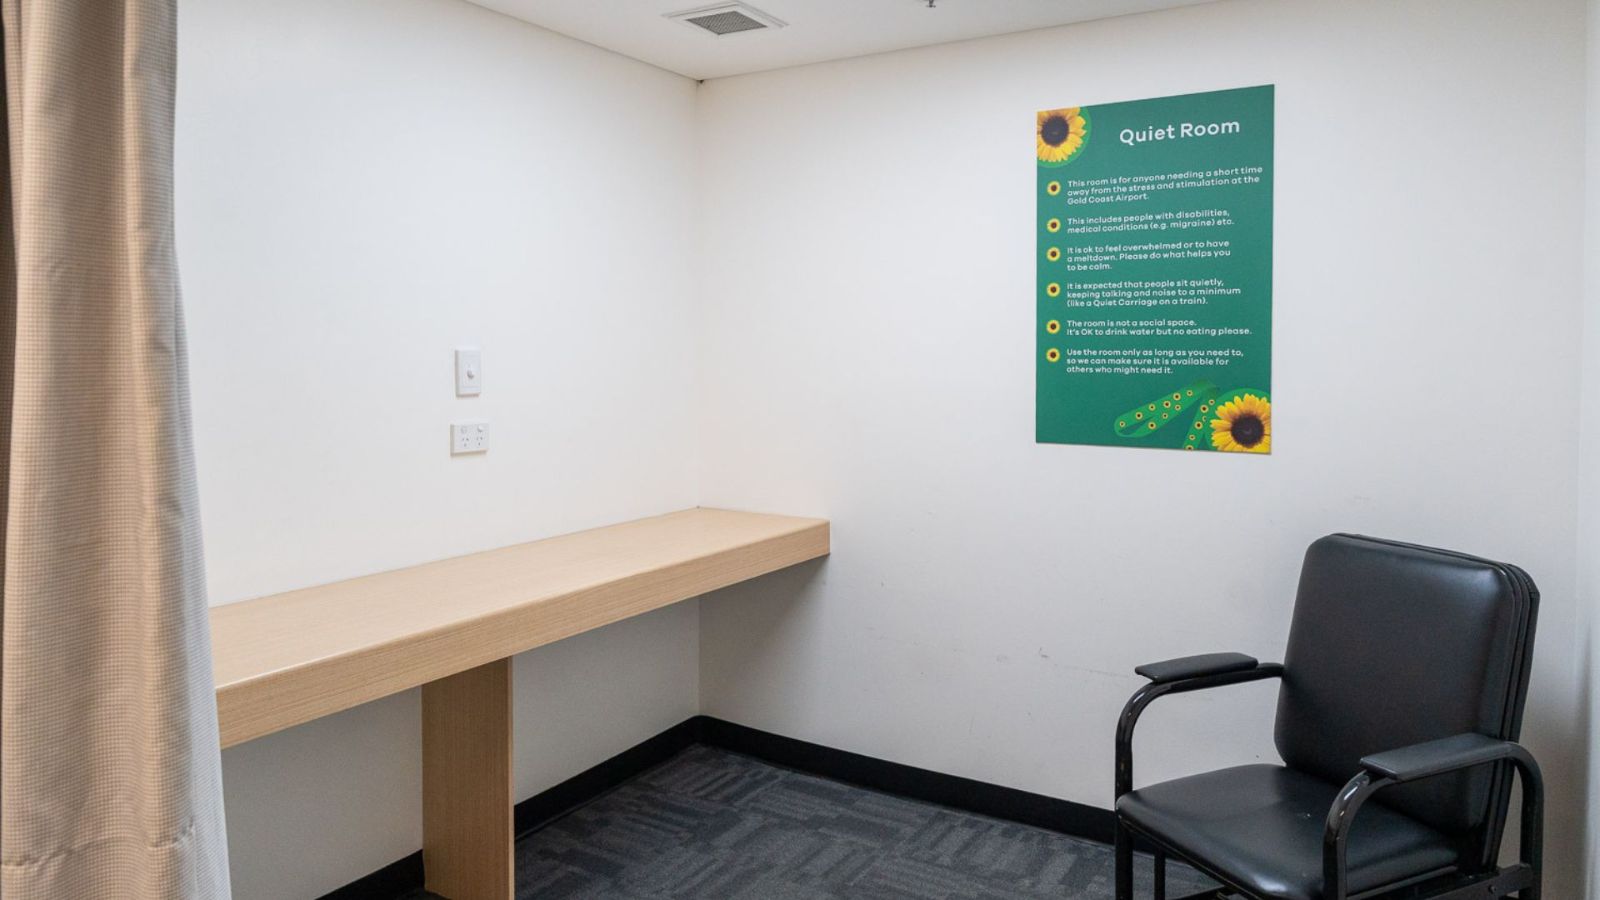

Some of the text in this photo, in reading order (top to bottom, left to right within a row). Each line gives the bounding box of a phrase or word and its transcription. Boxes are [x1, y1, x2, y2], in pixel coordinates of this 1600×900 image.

[1119, 121, 1240, 145] Quiet Room
[1119, 176, 1131, 184] for
[1133, 175, 1165, 184] anyone
[1167, 171, 1203, 179] needing
[1214, 168, 1239, 176] short
[1068, 189, 1089, 197] away
[1129, 184, 1155, 192] stress
[1157, 182, 1174, 190] and
[1176, 178, 1229, 188] stimulation
[1244, 176, 1259, 184] the
[1068, 197, 1087, 205] Gold
[1116, 193, 1149, 201] Airport.
[1087, 216, 1121, 224] includes
[1124, 214, 1153, 223] people
[1176, 209, 1229, 219] disabilities,
[1068, 225, 1101, 233] medical
[1102, 223, 1148, 232] conditions
[1150, 222, 1168, 230] (e.g.
[1171, 220, 1215, 228] migraine)
[1106, 244, 1121, 252] feel
[1123, 242, 1181, 251] overwhelmed
[1074, 253, 1117, 262] meltdown.
[1120, 252, 1147, 260] Please
[1187, 250, 1212, 258] helps
[1083, 281, 1122, 290] expected
[1145, 280, 1175, 289] people
[1190, 278, 1223, 287] quietly,
[1067, 291, 1100, 299] keeping
[1102, 290, 1132, 298] talking
[1094, 299, 1117, 307] Quiet
[1180, 297, 1208, 305] train).
[1168, 319, 1197, 327] space.
[1186, 328, 1216, 336] eating
[1218, 328, 1252, 336] please.
[1123, 349, 1141, 358] only
[1155, 349, 1174, 358] long
[1114, 366, 1139, 375] might
